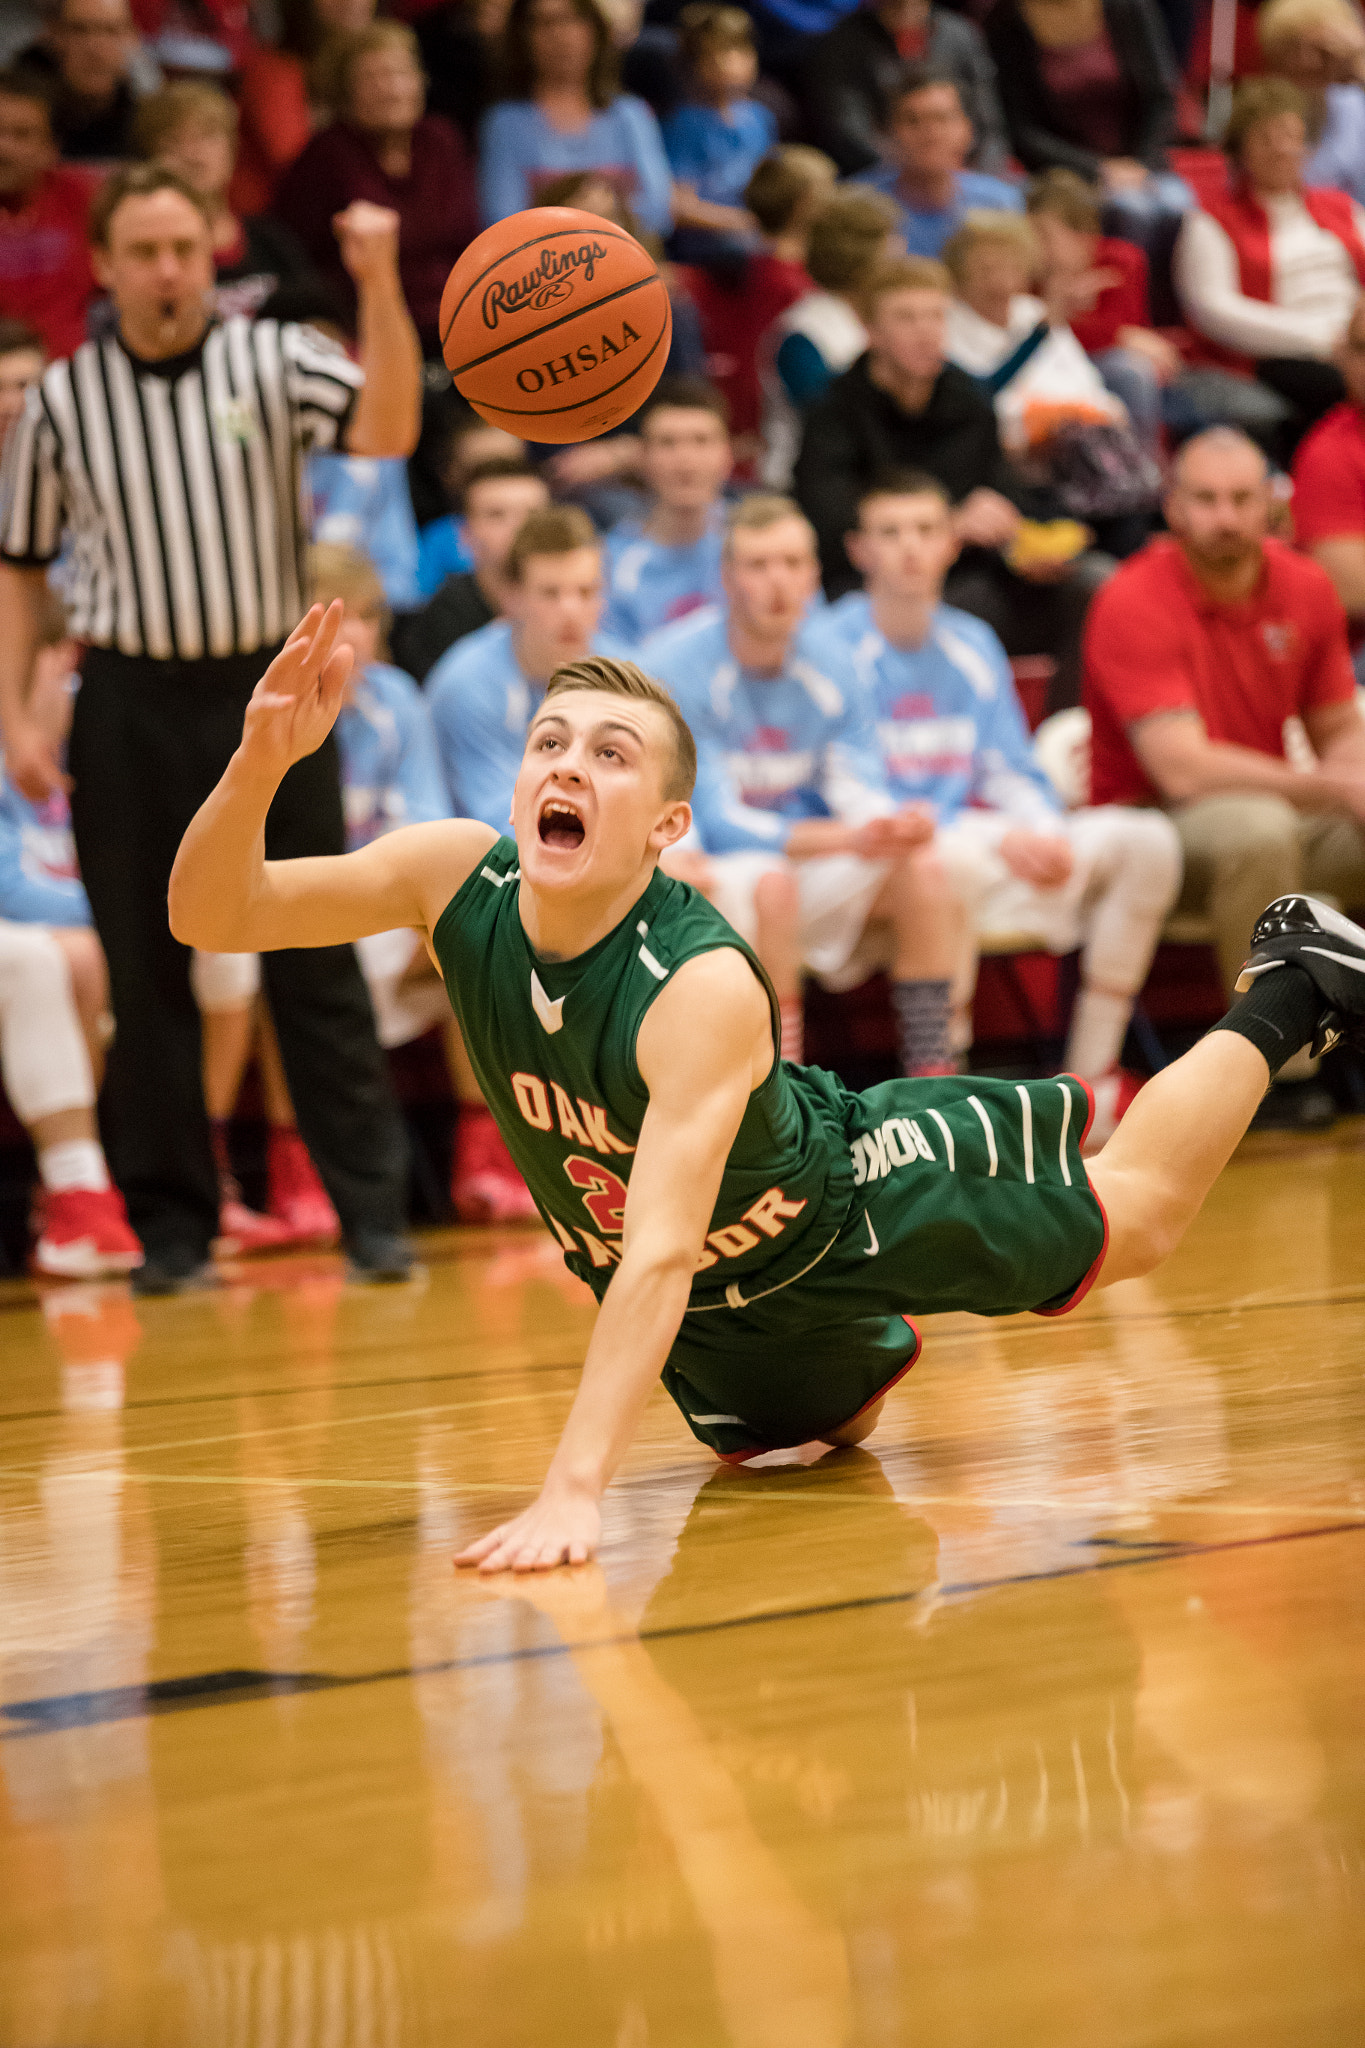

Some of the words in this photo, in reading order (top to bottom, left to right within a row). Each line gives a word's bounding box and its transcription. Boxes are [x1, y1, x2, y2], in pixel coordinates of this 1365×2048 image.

[481, 241, 608, 330] Rawlings
[516, 320, 642, 394] OHSAA
[510, 1071, 637, 1155] OAK
